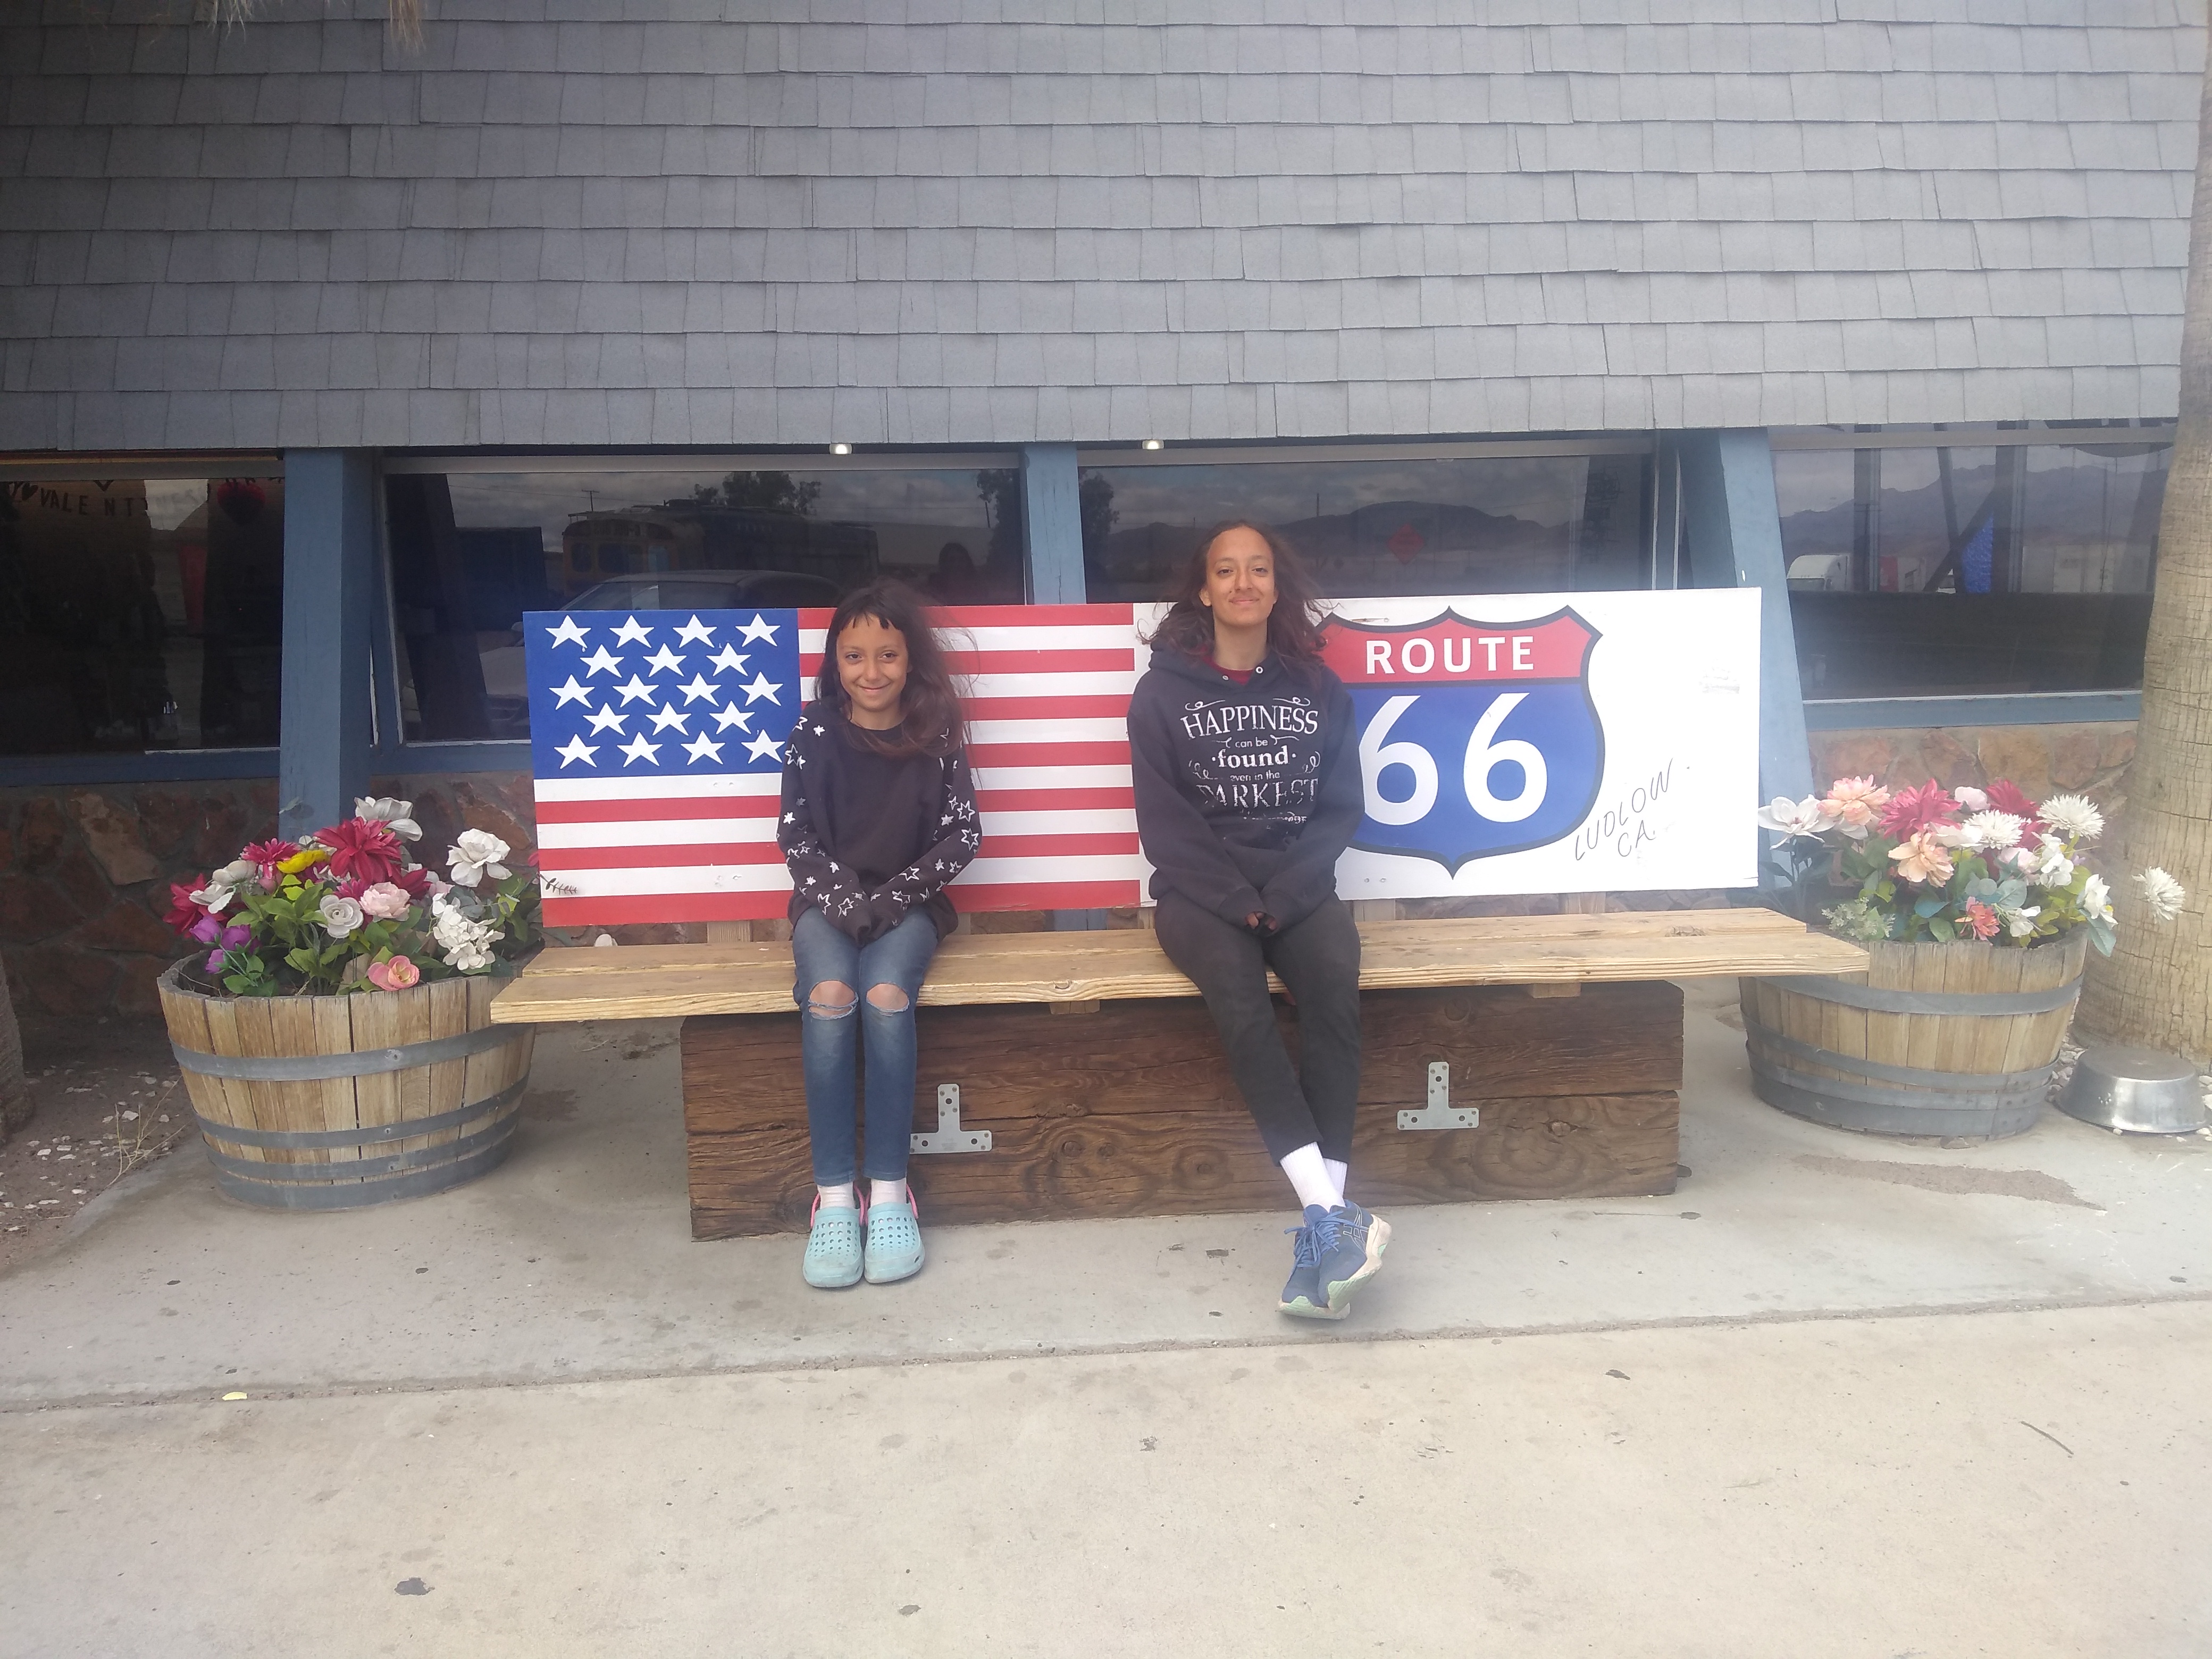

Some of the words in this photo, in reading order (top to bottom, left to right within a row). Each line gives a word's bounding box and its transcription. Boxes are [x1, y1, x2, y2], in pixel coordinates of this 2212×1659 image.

[1366, 636, 1534, 674] ROUTE
[1180, 705, 1319, 740] HAPPINESS
[1255, 736, 1268, 747] be
[1218, 745, 1289, 768] found
[1359, 692, 1548, 825] 66
[1266, 769, 1280, 780] the
